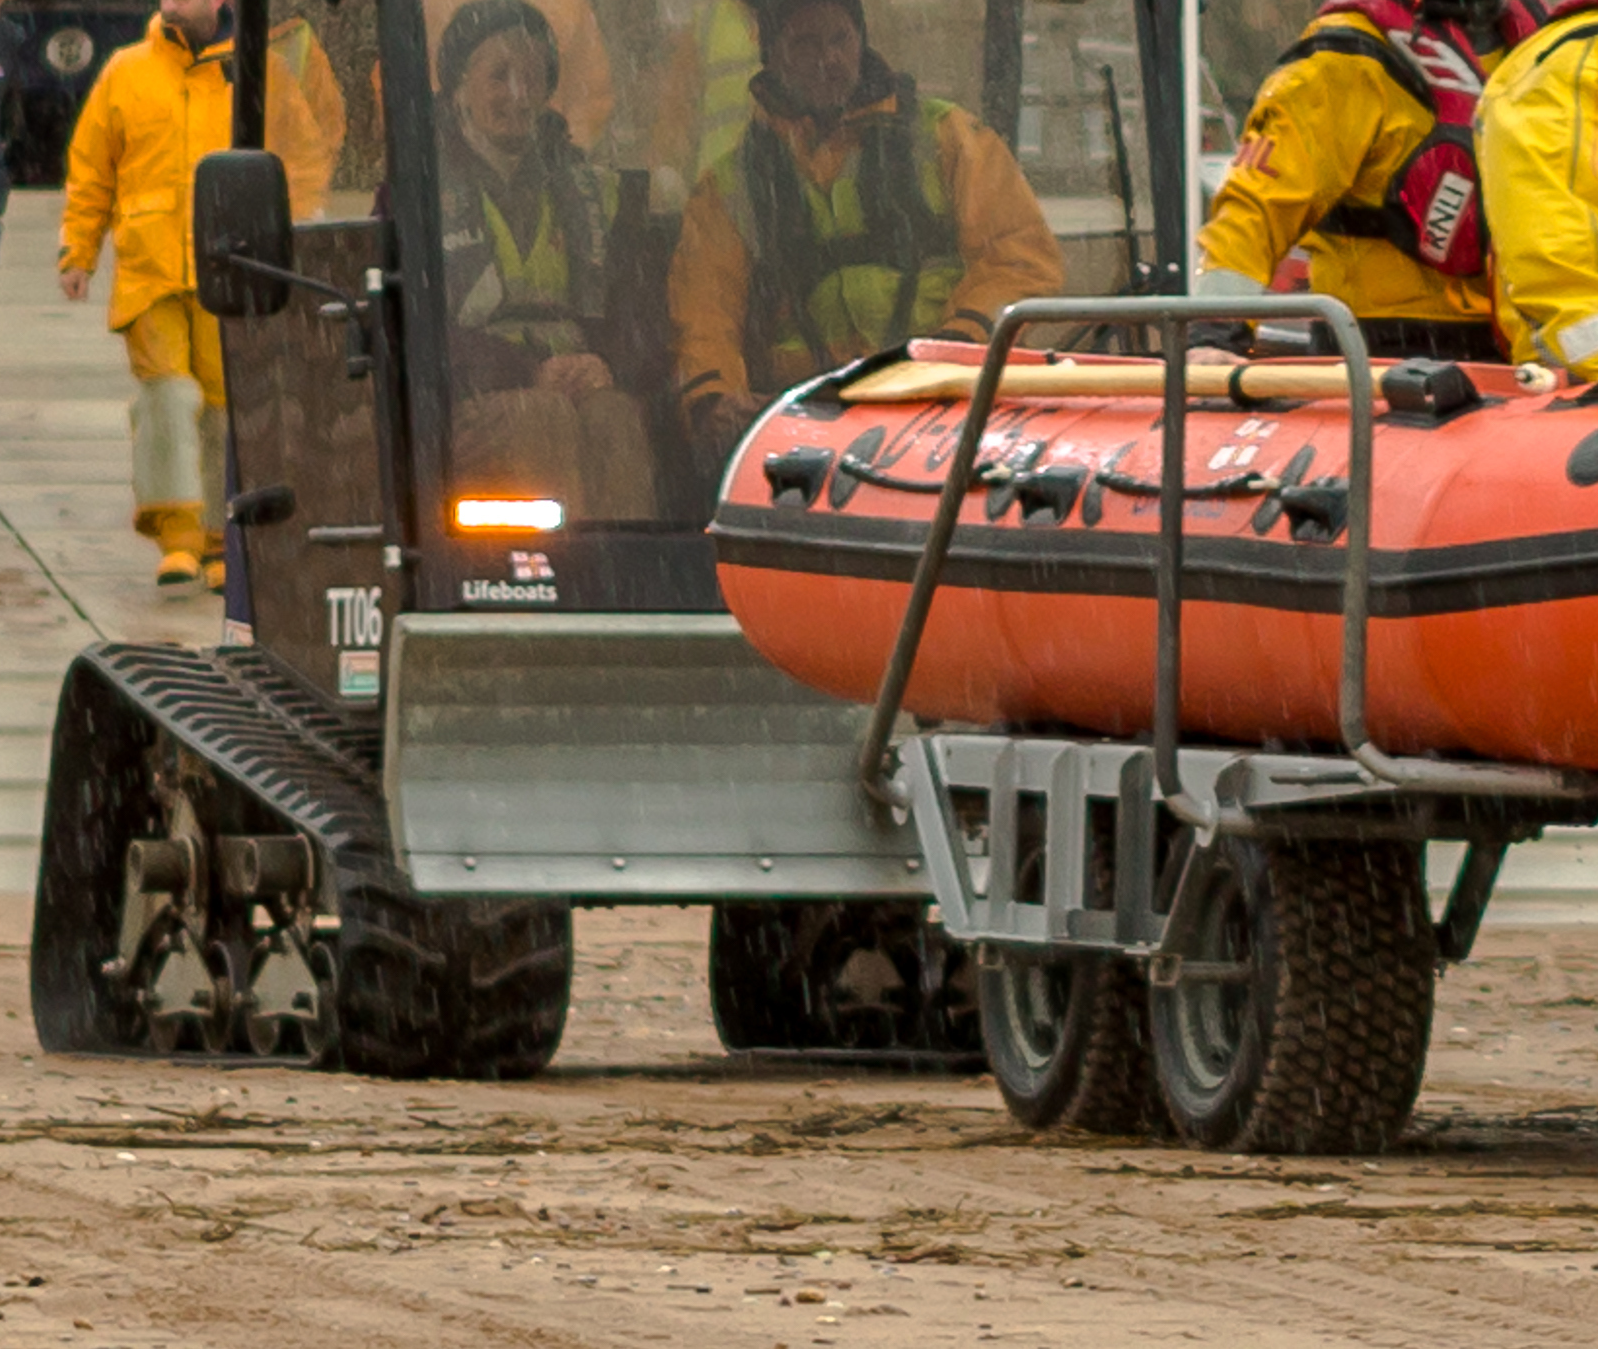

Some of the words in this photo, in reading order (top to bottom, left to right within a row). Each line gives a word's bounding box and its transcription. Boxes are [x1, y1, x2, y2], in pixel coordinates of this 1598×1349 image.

[1426, 184, 1465, 251] RNLI
[326, 586, 383, 647] TT06
[462, 580, 557, 602] Lifeboats
